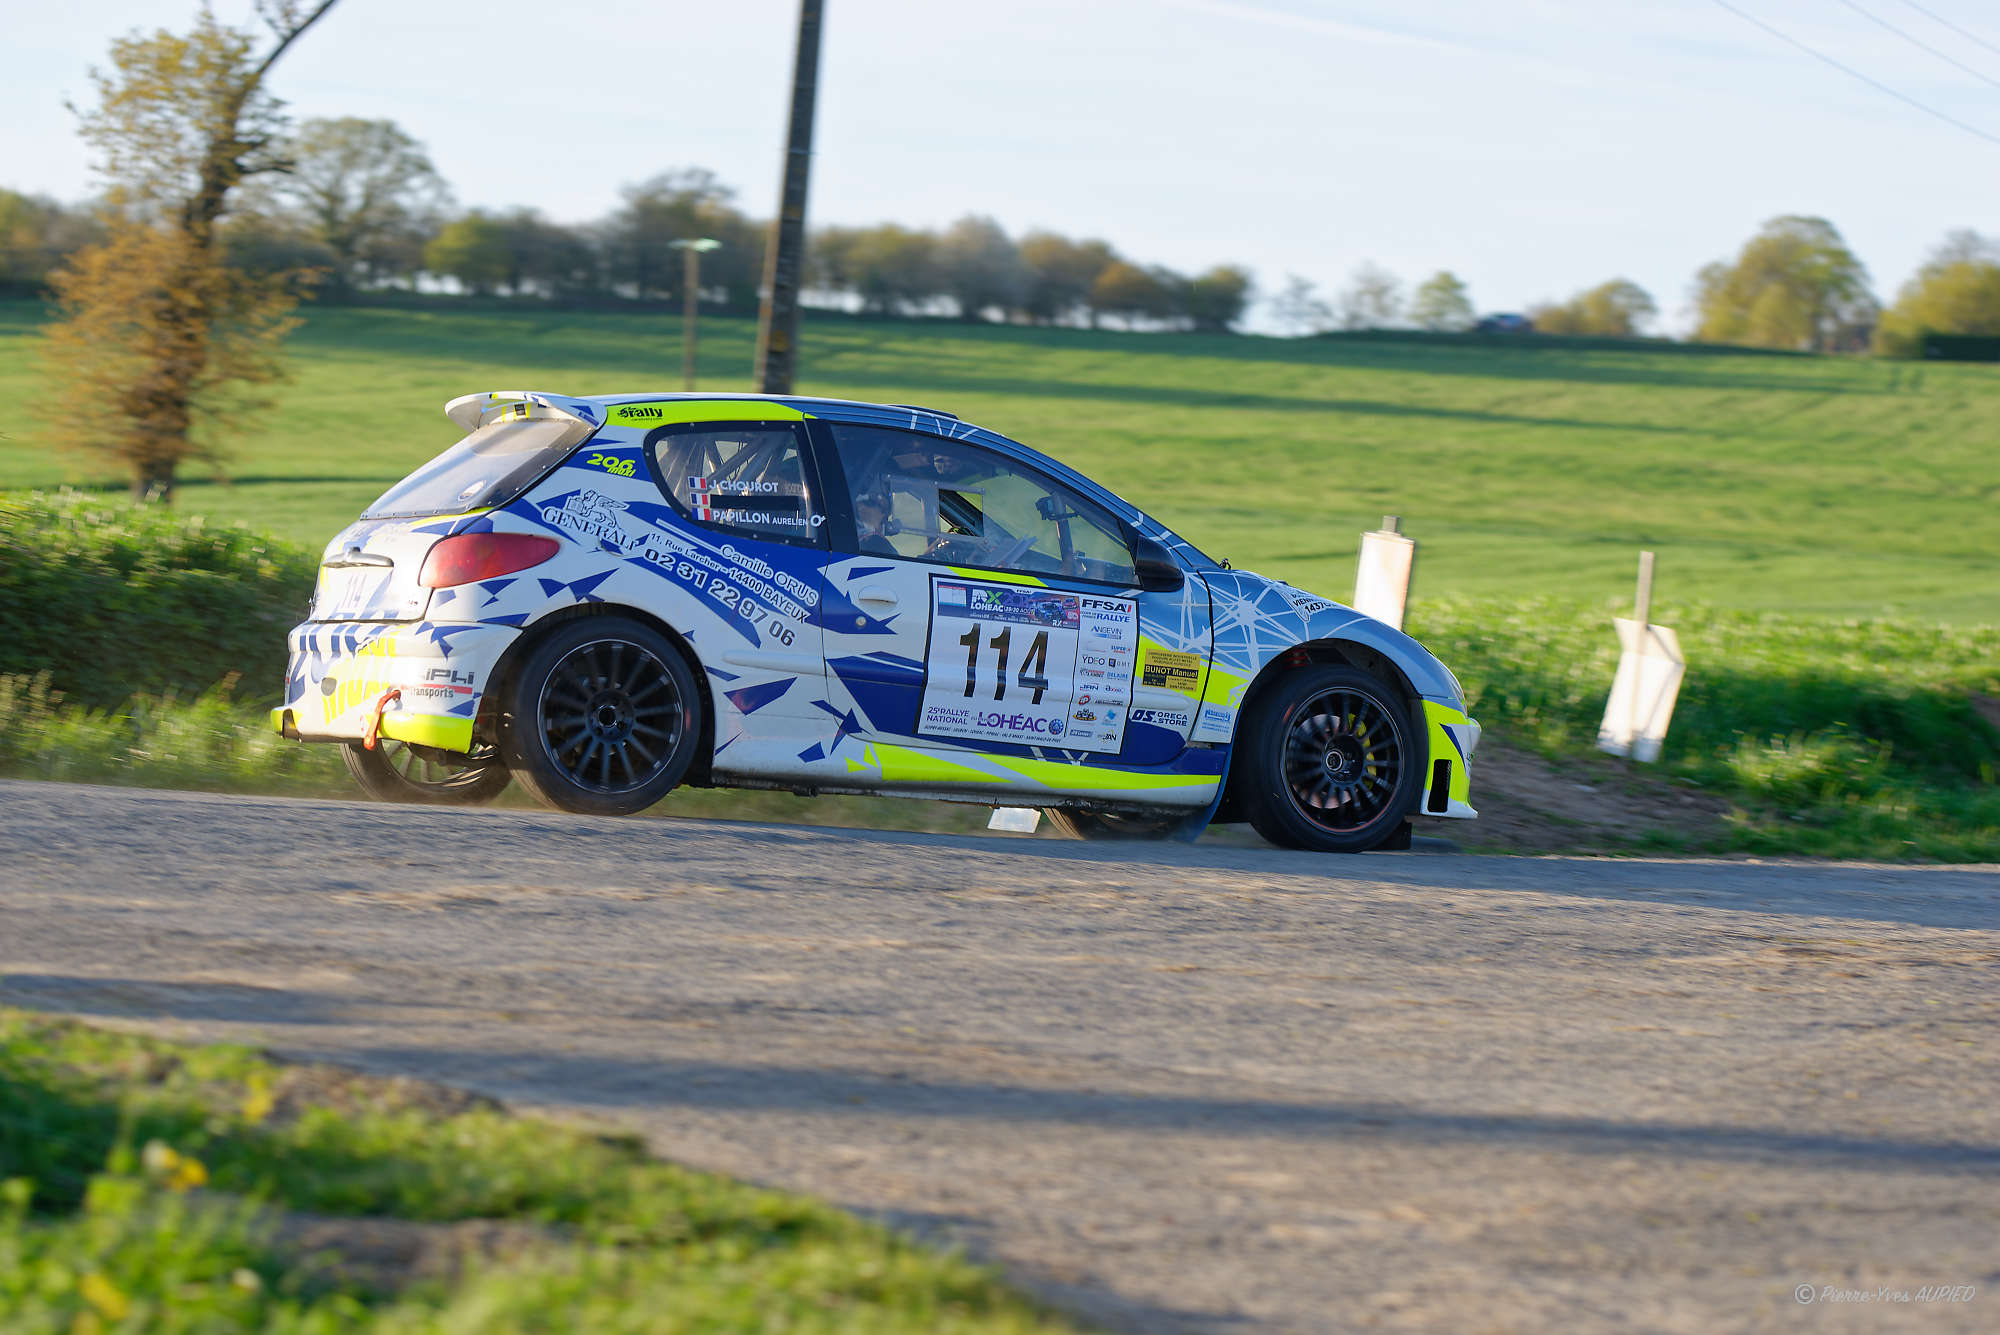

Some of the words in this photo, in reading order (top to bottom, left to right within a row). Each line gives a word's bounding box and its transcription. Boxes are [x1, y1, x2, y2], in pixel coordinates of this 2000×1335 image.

[587, 453, 635, 470] 206
[719, 481, 779, 493] CHOUROT
[713, 510, 770, 524] PAPILLON
[772, 518, 808, 527] AURELIEN
[665, 540, 682, 553] Rue
[685, 548, 719, 571] Larcher
[730, 568, 764, 594] 14400
[763, 585, 811, 624] BAYEUX
[722, 546, 774, 578] Camille
[775, 572, 819, 606] ORUS
[644, 548, 676, 571] 02
[677, 562, 709, 588] 31
[708, 578, 741, 611] 22
[740, 599, 769, 624] 97
[768, 620, 796, 646] 06
[1082, 599, 1126, 613] FFSA
[1096, 613, 1131, 623] RALLYE
[960, 623, 1048, 705] 114
[1145, 665, 1170, 675] BUNOT
[1173, 668, 1198, 678] Manuel
[939, 707, 969, 717] RALLYE
[1157, 711, 1188, 720] ORECA
[926, 715, 968, 725] NATIONAL
[977, 712, 1048, 733] LOHÉAC
